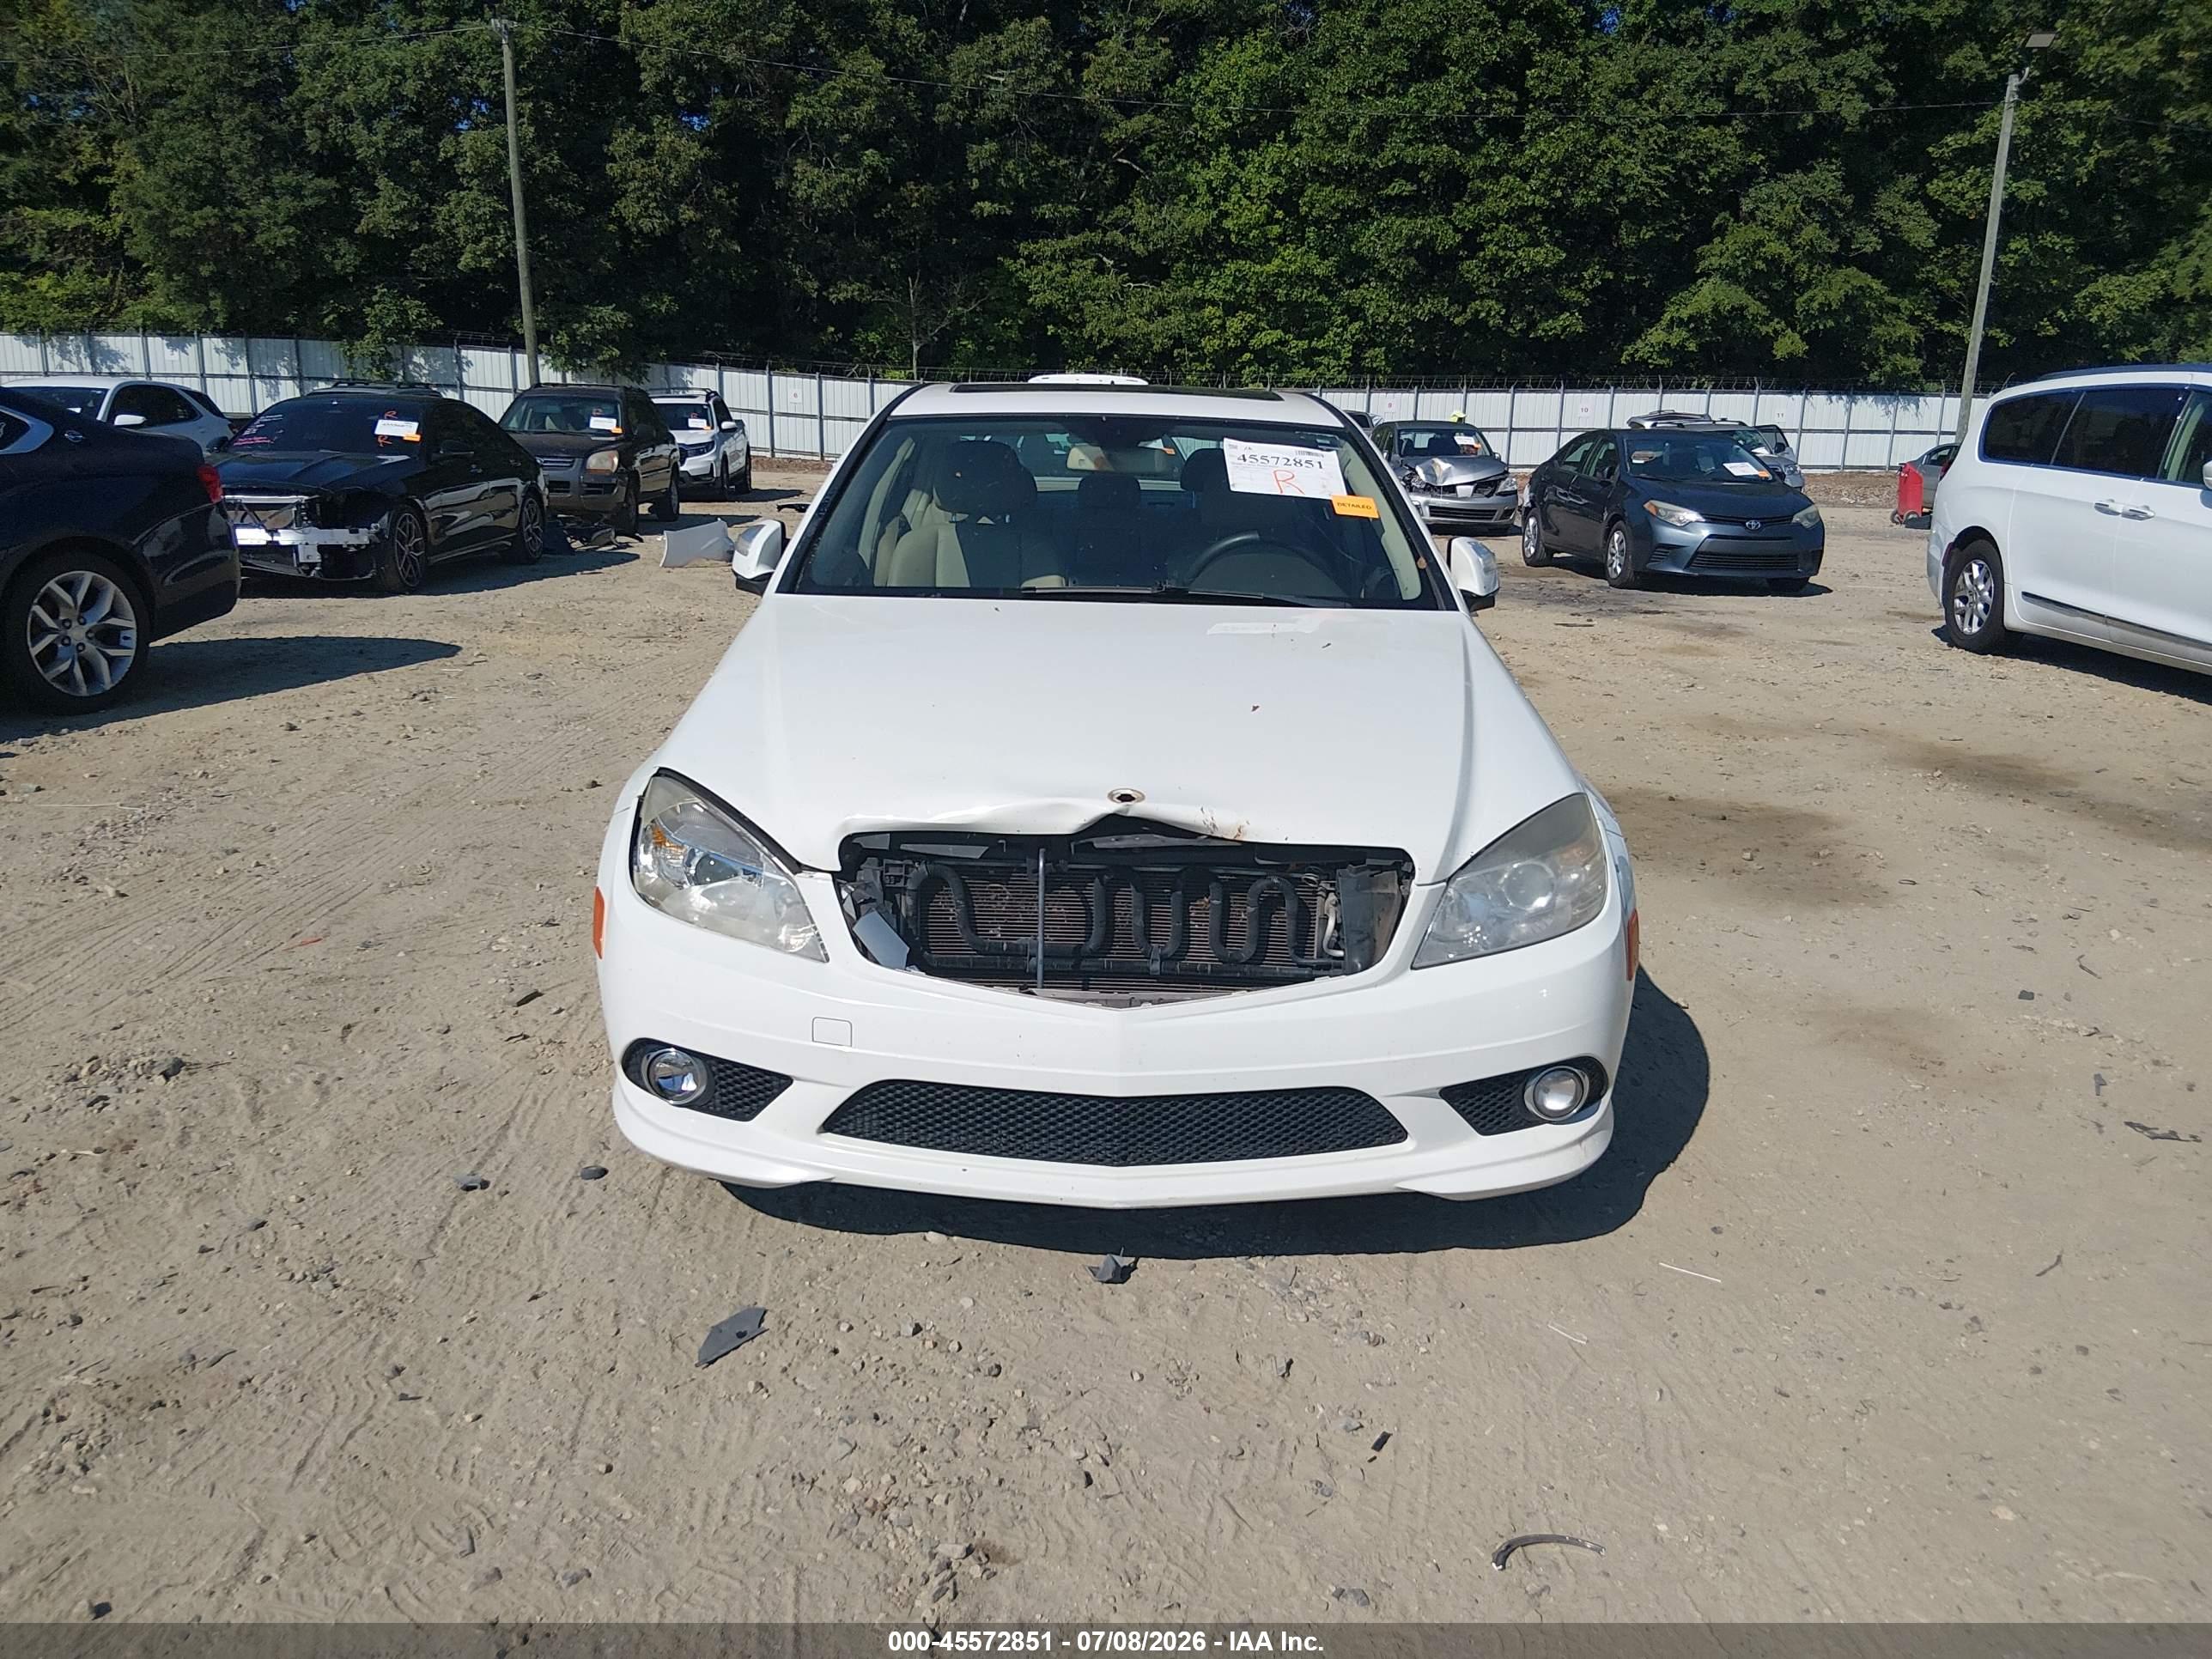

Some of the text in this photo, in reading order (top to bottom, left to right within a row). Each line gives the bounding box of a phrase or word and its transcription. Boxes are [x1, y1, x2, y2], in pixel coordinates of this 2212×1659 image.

[1237, 453, 1323, 470] 45572851
[1273, 469, 1305, 495] R
[1336, 501, 1372, 510] DETAILED
